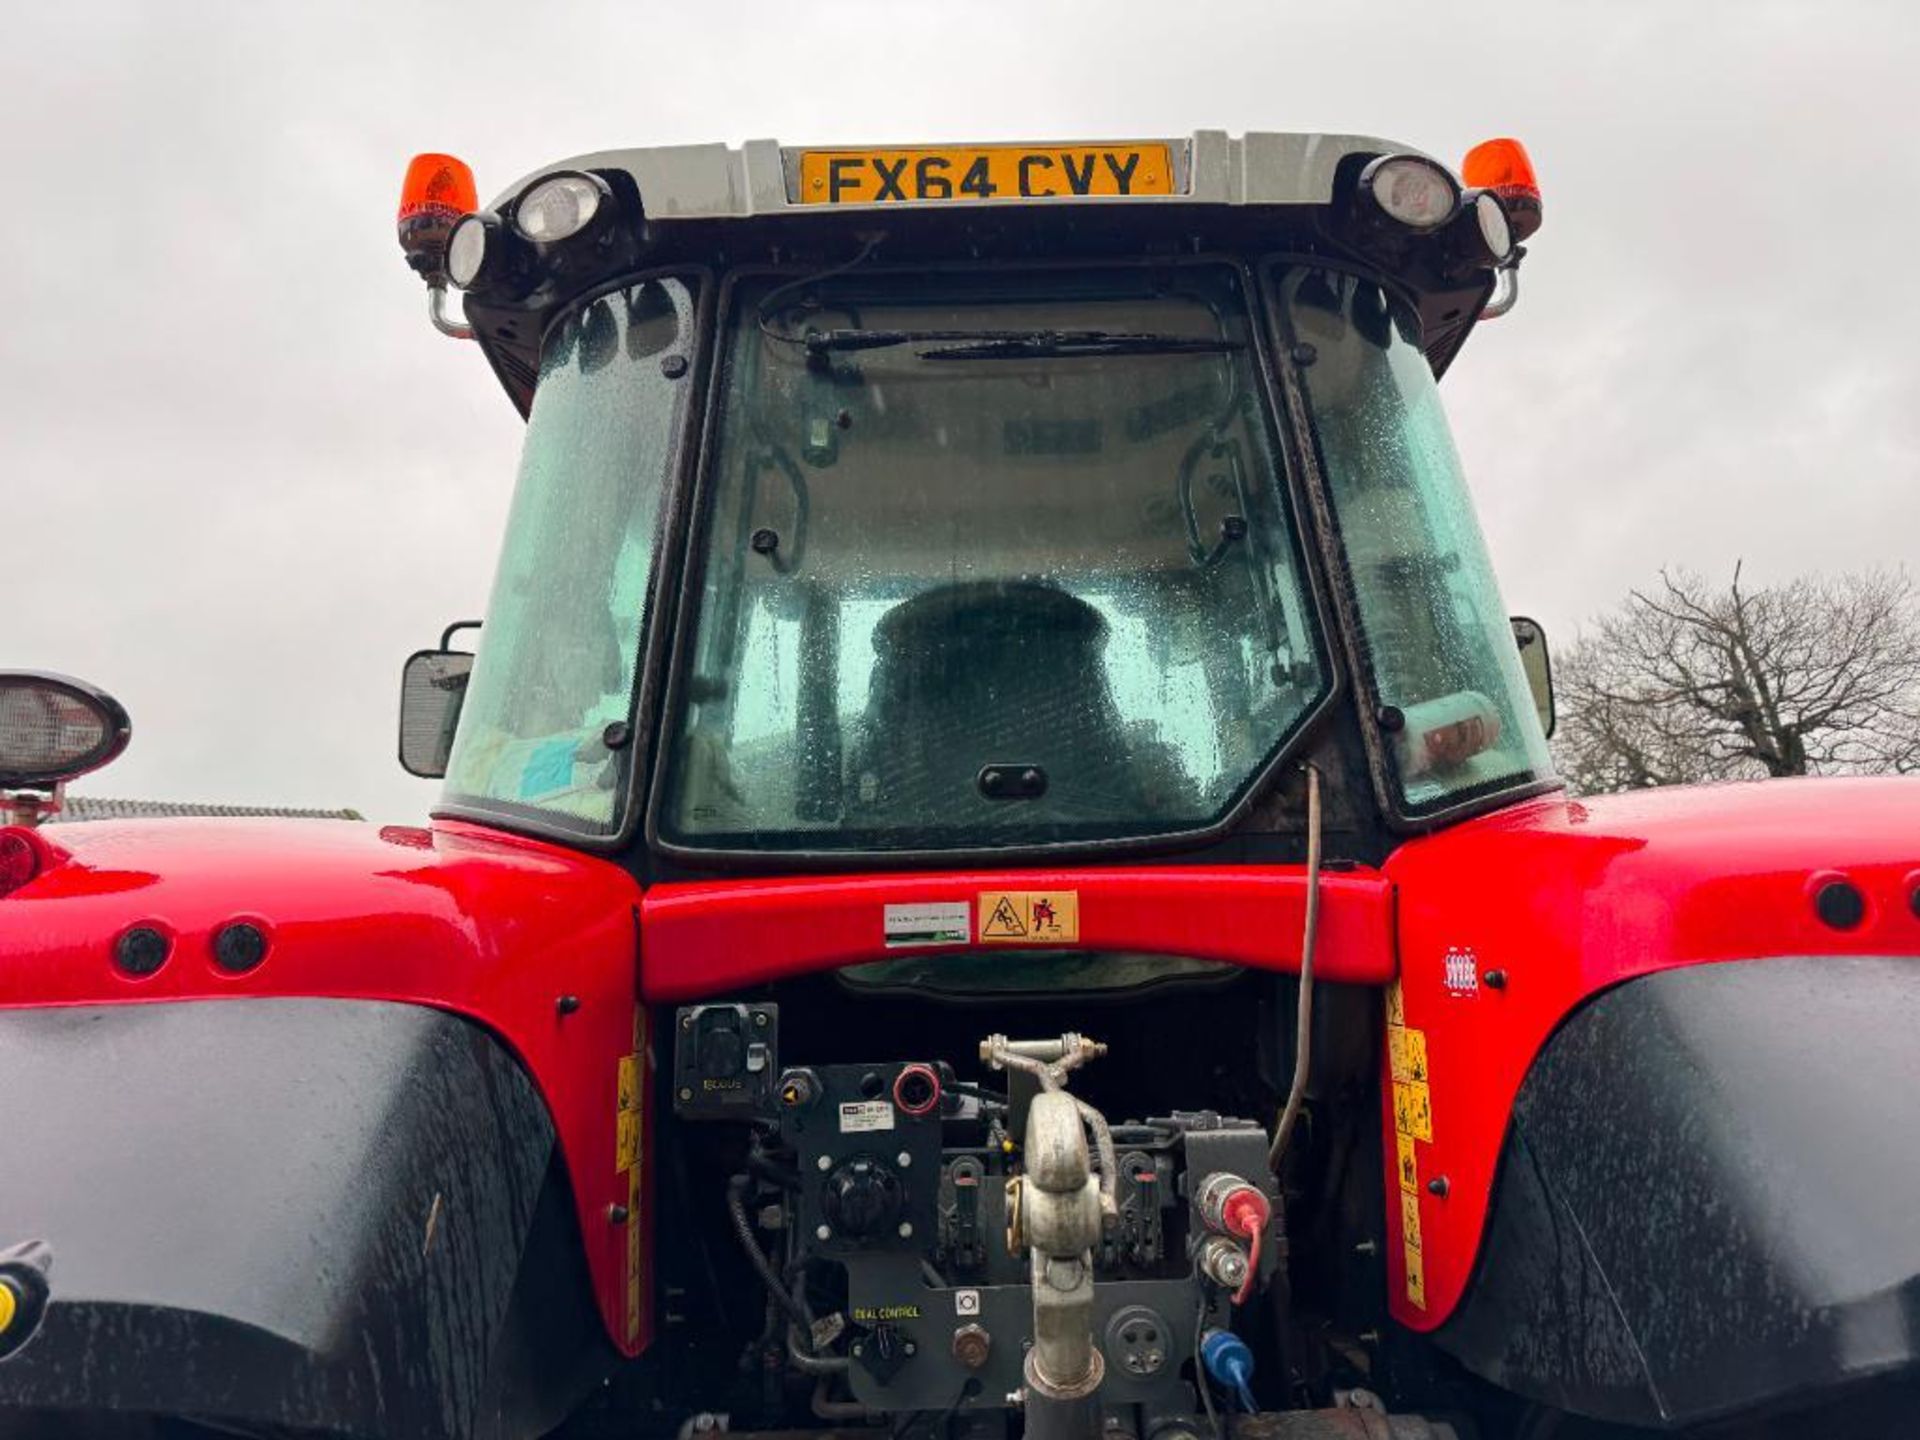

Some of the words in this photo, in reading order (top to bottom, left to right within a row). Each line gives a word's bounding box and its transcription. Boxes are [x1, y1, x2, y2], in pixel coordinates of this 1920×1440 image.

[828, 156, 997, 203] FX64
[1018, 152, 1140, 198] CVY
[879, 1305, 921, 1318] CONTROL
